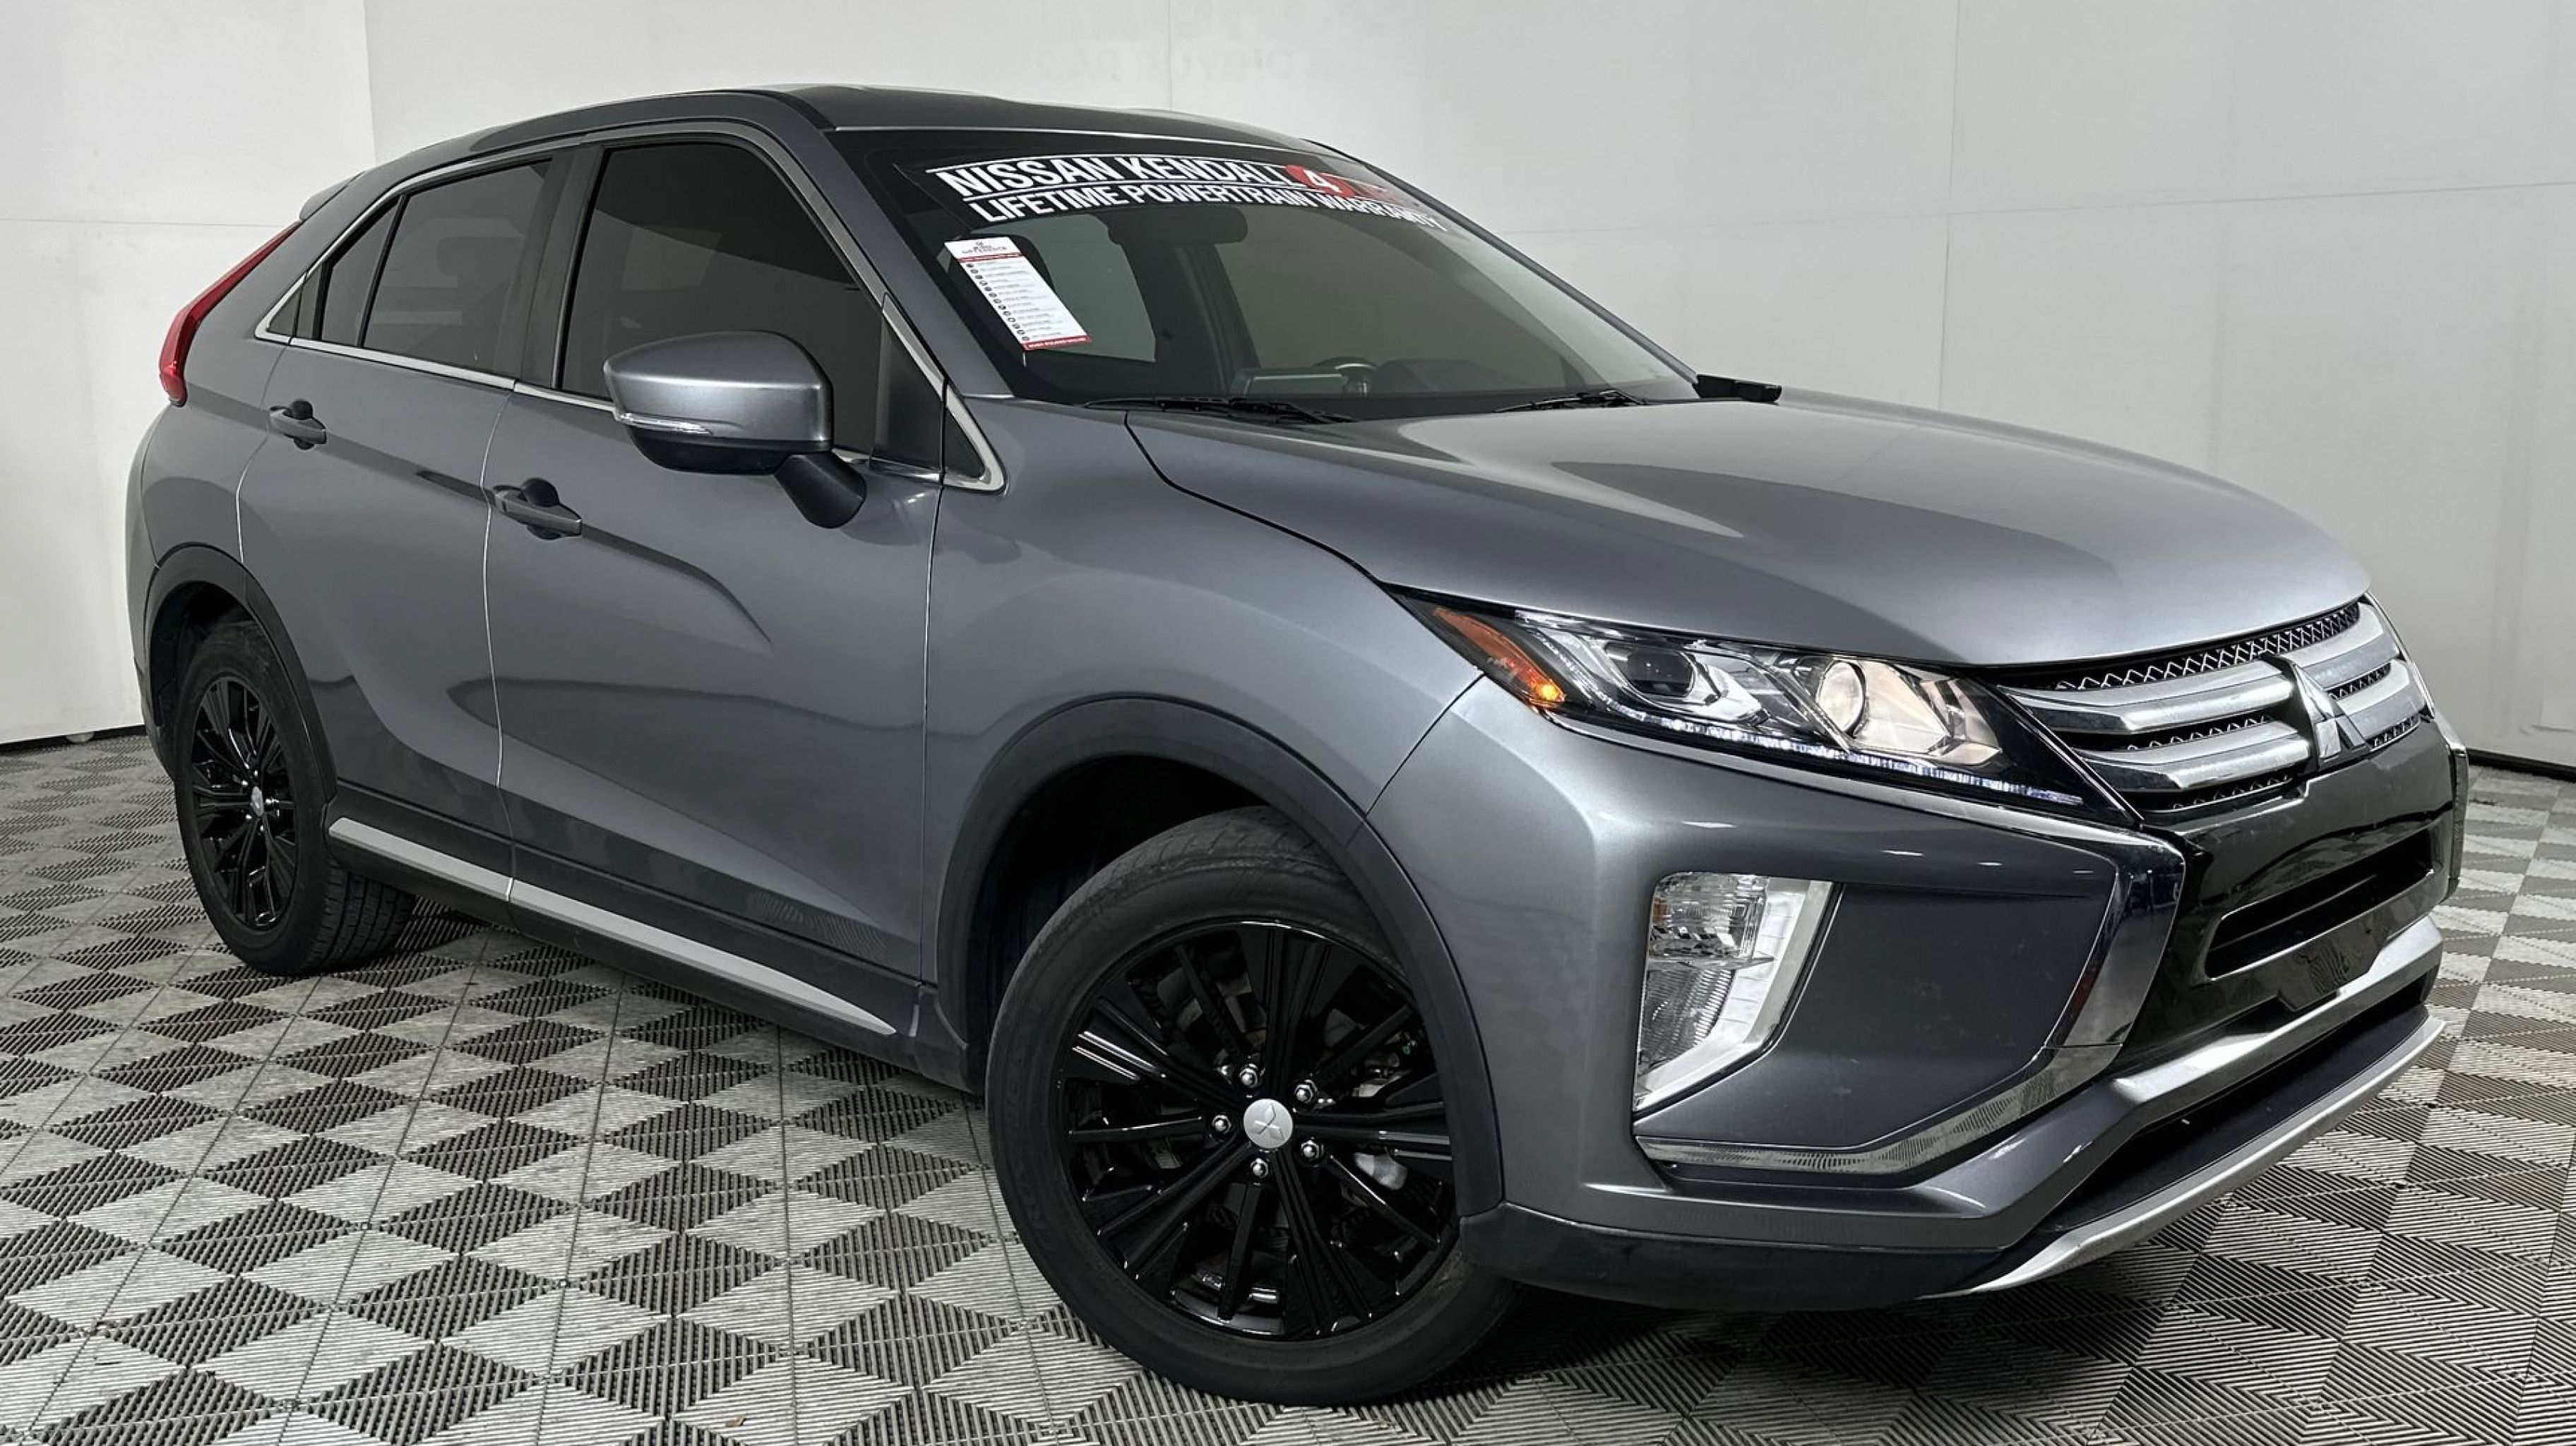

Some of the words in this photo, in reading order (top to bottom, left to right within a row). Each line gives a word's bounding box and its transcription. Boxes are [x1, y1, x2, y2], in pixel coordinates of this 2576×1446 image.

[936, 157, 1124, 196] NISSAN
[1115, 157, 1306, 187] KENDALL
[970, 186, 1130, 222] LIFETIME
[1118, 184, 1318, 207] POWERTRAIN
